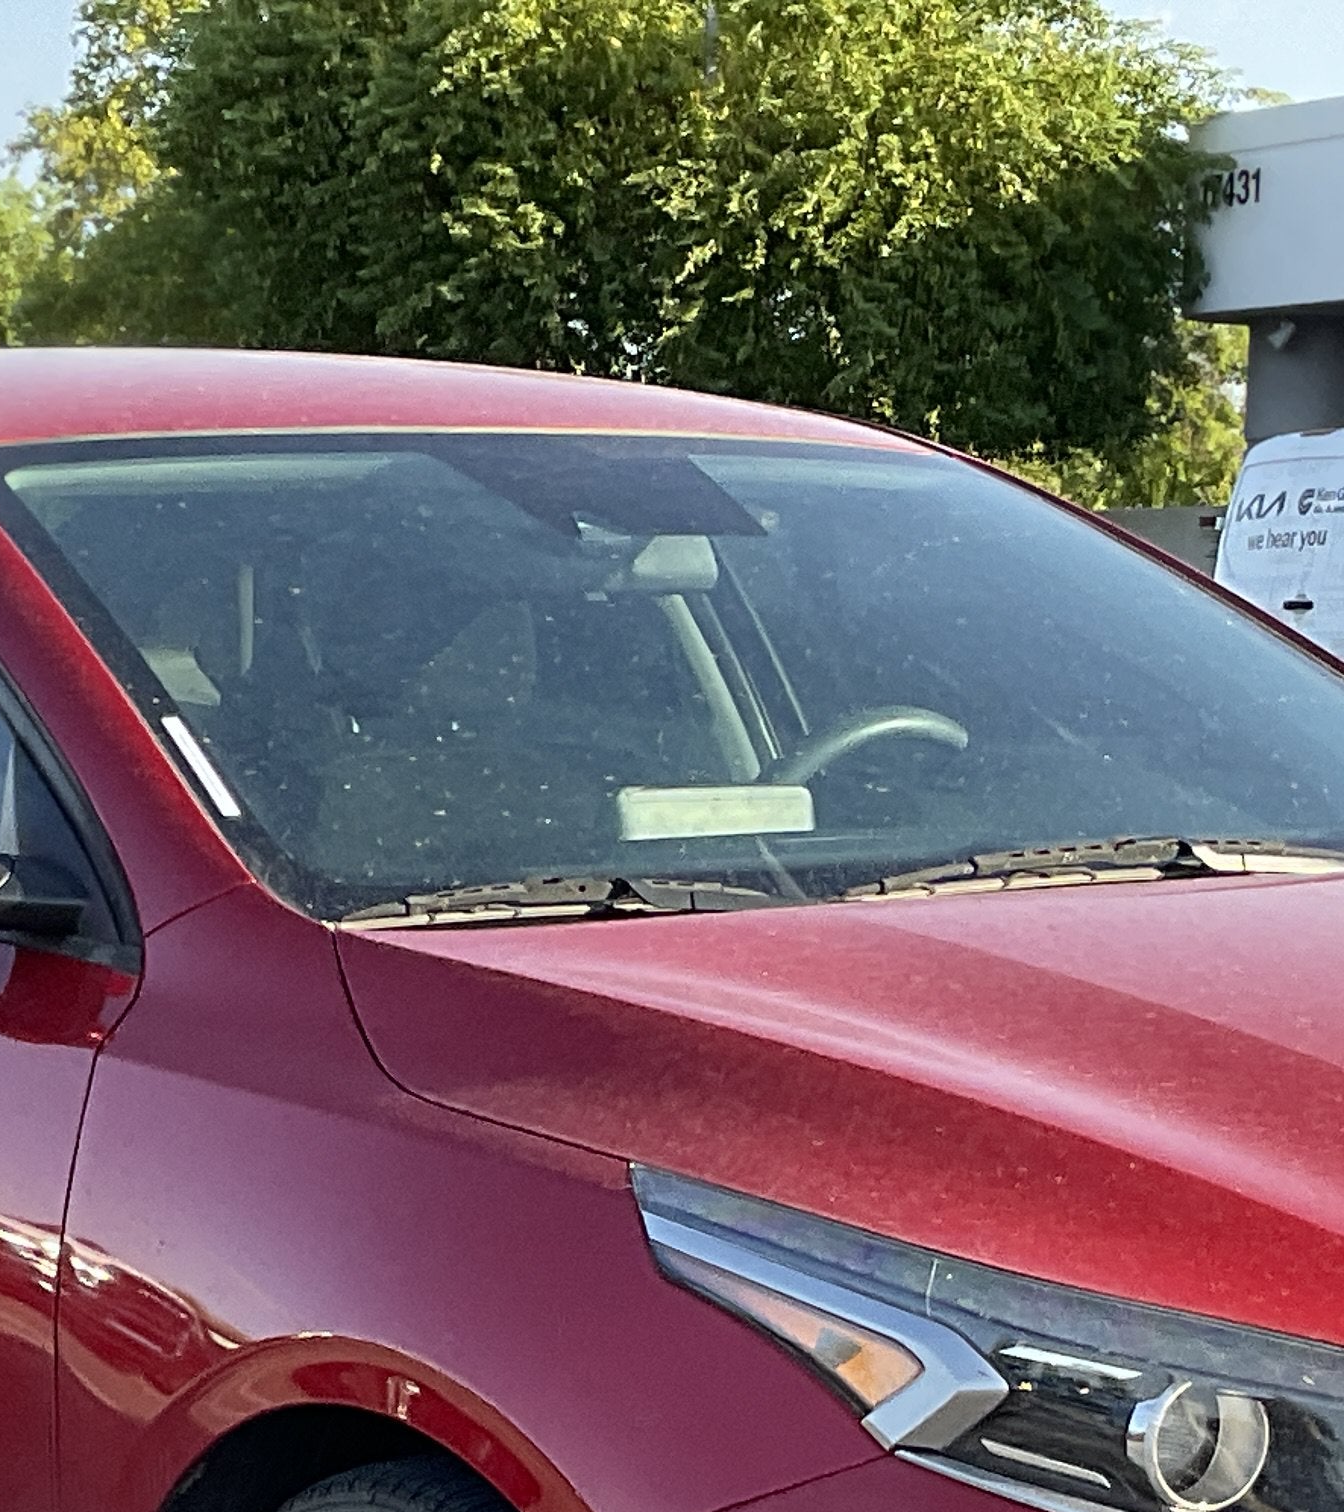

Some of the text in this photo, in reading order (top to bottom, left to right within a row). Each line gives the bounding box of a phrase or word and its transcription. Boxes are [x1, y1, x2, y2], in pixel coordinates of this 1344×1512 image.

[1236, 491, 1287, 522] KIA
[1266, 528, 1298, 549] hear
[1297, 529, 1328, 552] you
